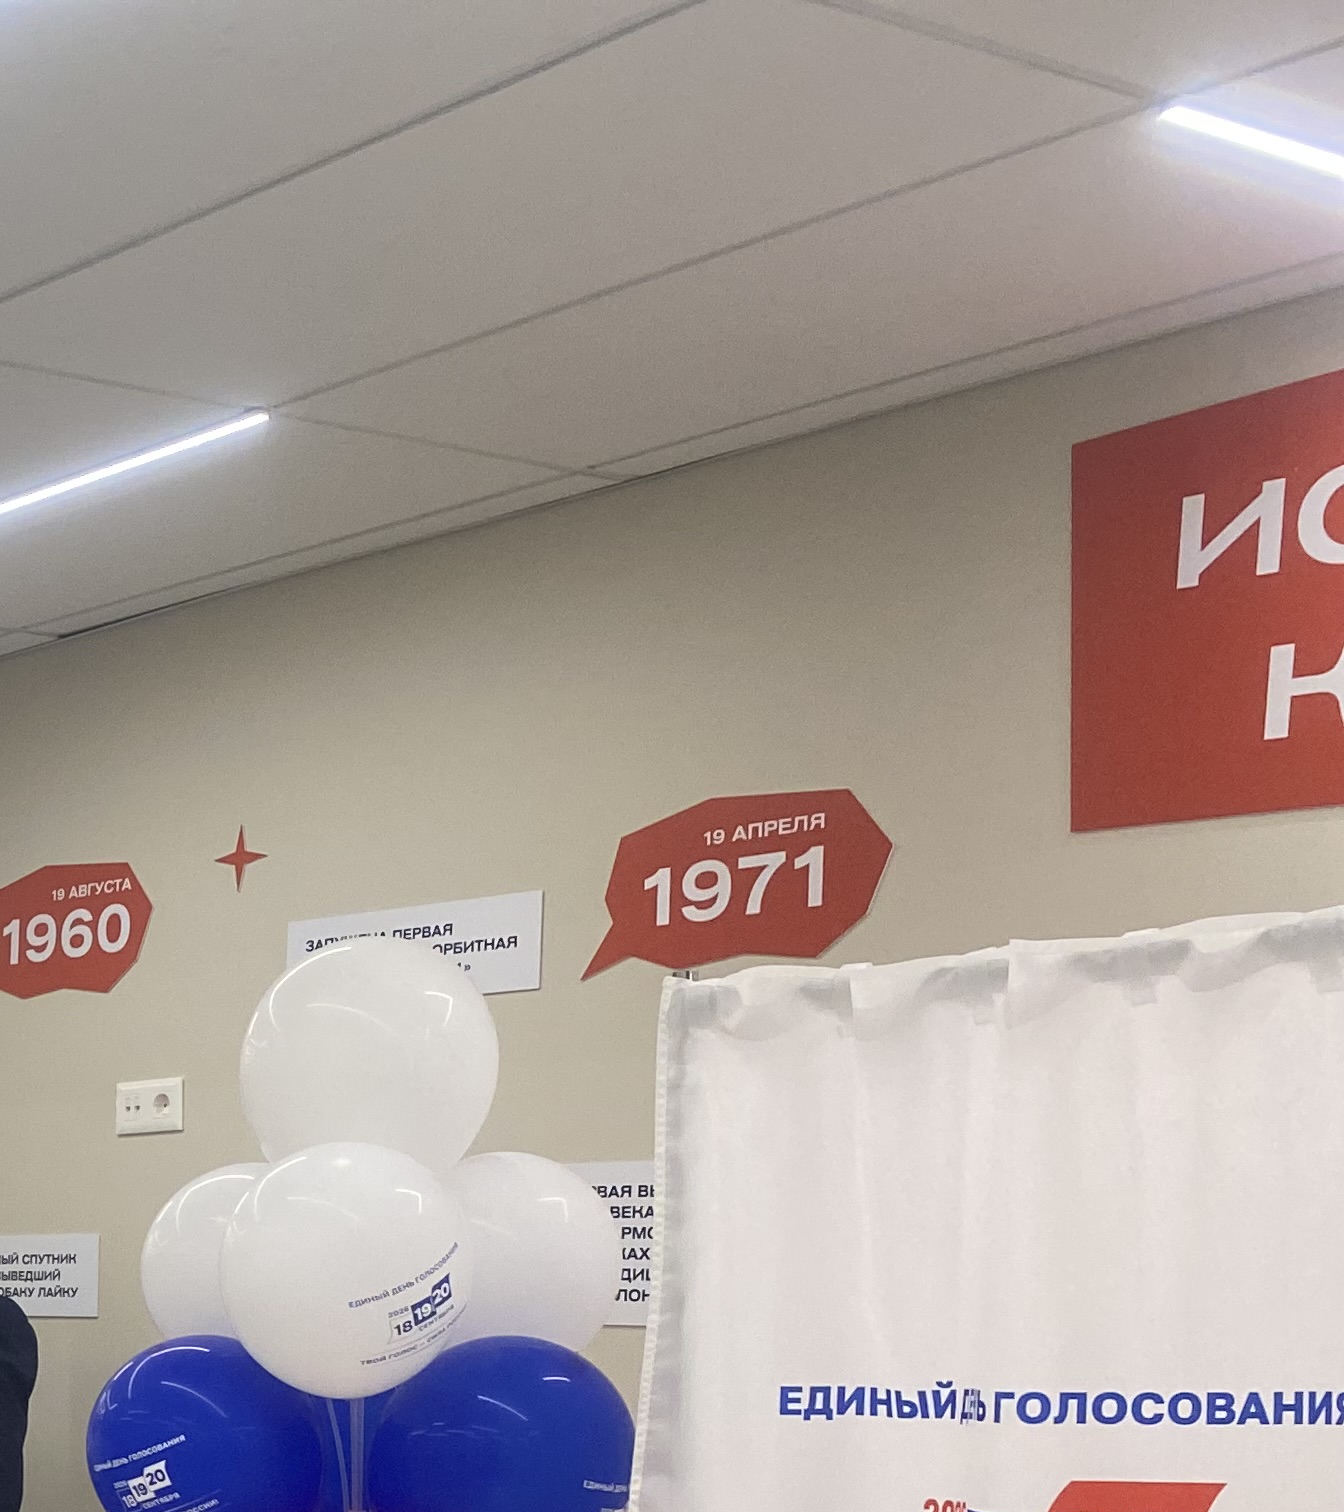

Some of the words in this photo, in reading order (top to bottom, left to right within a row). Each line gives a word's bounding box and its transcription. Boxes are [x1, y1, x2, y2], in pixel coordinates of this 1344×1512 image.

[704, 830, 725, 845] 19
[732, 813, 826, 842] АПРЕЛЯ
[52, 888, 65, 901] 19
[69, 878, 132, 899] АВГУСТА
[644, 846, 824, 926] 1971
[3, 903, 131, 965] 1960
[393, 923, 453, 940] ПЕРВАЯ
[592, 1185, 632, 1198] ВАЯ
[22, 1254, 77, 1265] СПУТНИК
[38, 1285, 79, 1298] ЛАЙКУ
[348, 1289, 390, 1308] ЕДИНЫЙ
[392, 1281, 415, 1296] ДЕНЬ
[394, 1320, 413, 1336] 18
[414, 1303, 432, 1320] 19
[433, 1282, 450, 1303] 20
[779, 1380, 956, 1420] ЕДИНЫЙ
[994, 1391, 1344, 1426] ГОЛОСОВАНИ
[128, 1434, 186, 1461] ГОЛОСОВАНИЯ
[132, 1483, 148, 1497] 19
[146, 1469, 166, 1486] 20
